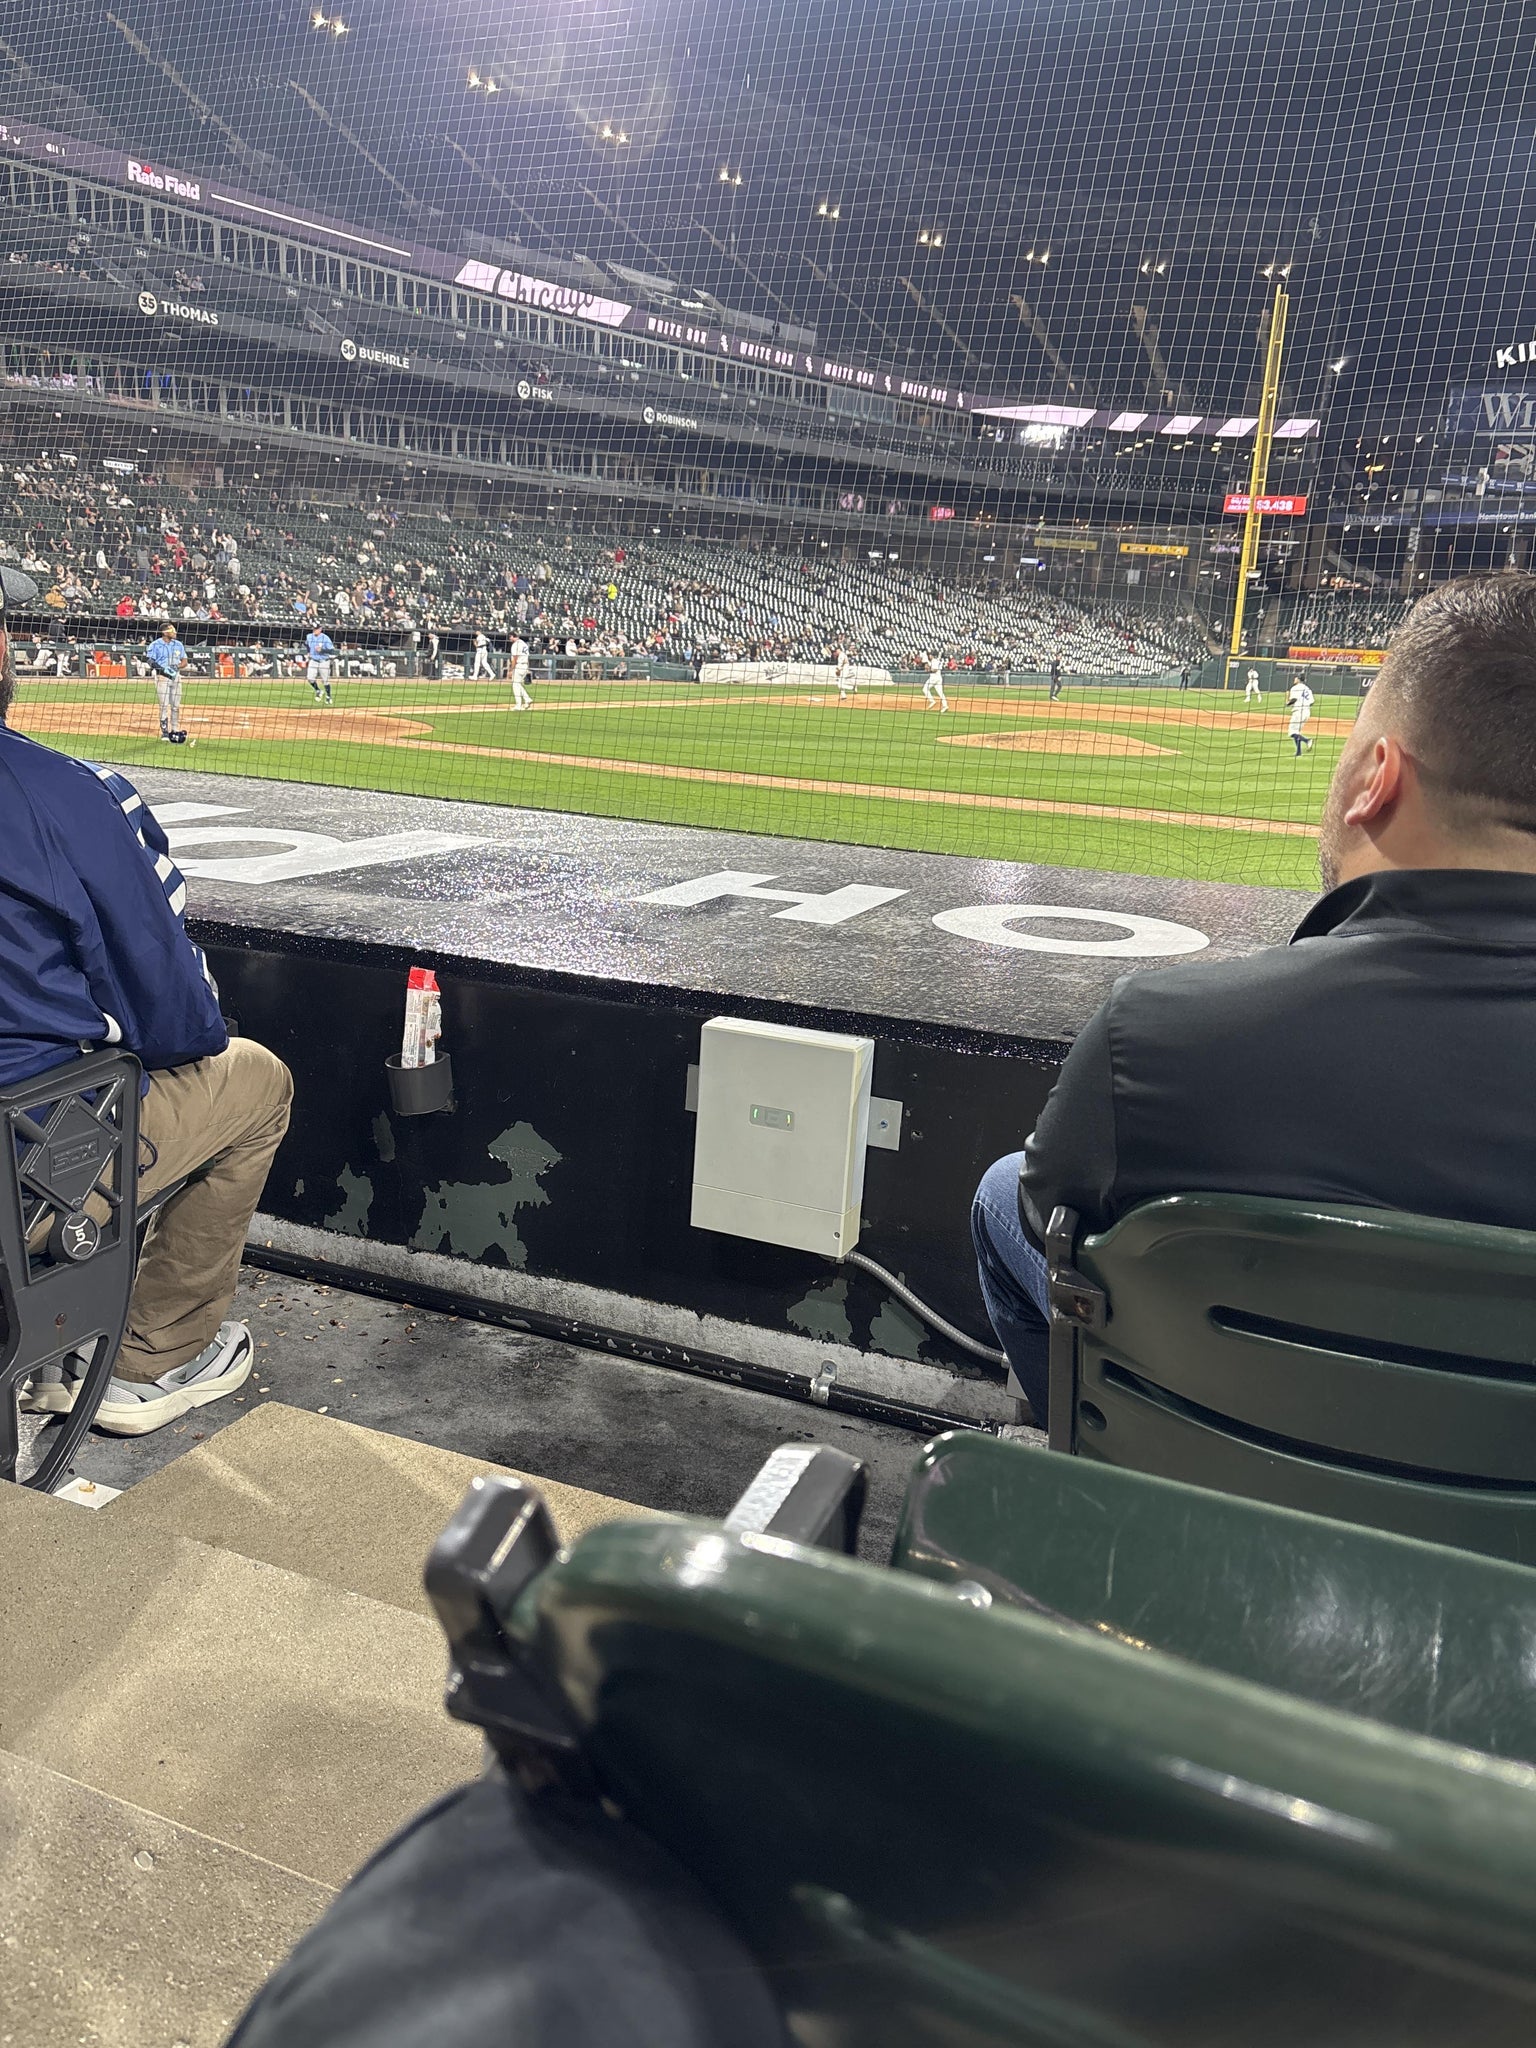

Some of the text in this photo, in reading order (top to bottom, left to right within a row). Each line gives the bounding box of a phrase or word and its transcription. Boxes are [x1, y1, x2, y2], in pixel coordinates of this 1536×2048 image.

[127, 160, 200, 200] Rate Field
[492, 268, 595, 316] Chicago
[161, 300, 219, 326] THOMAS
[647, 316, 682, 339] WHITE
[740, 341, 772, 361] WHITE
[359, 347, 410, 369] BUEHRLE
[532, 387, 553, 401] FISK
[656, 412, 698, 430] ROBINSON
[1346, 513, 1395, 524] WINTRUST
[1478, 512, 1518, 521] Hometown
[75, 1228, 86, 1242] 5
